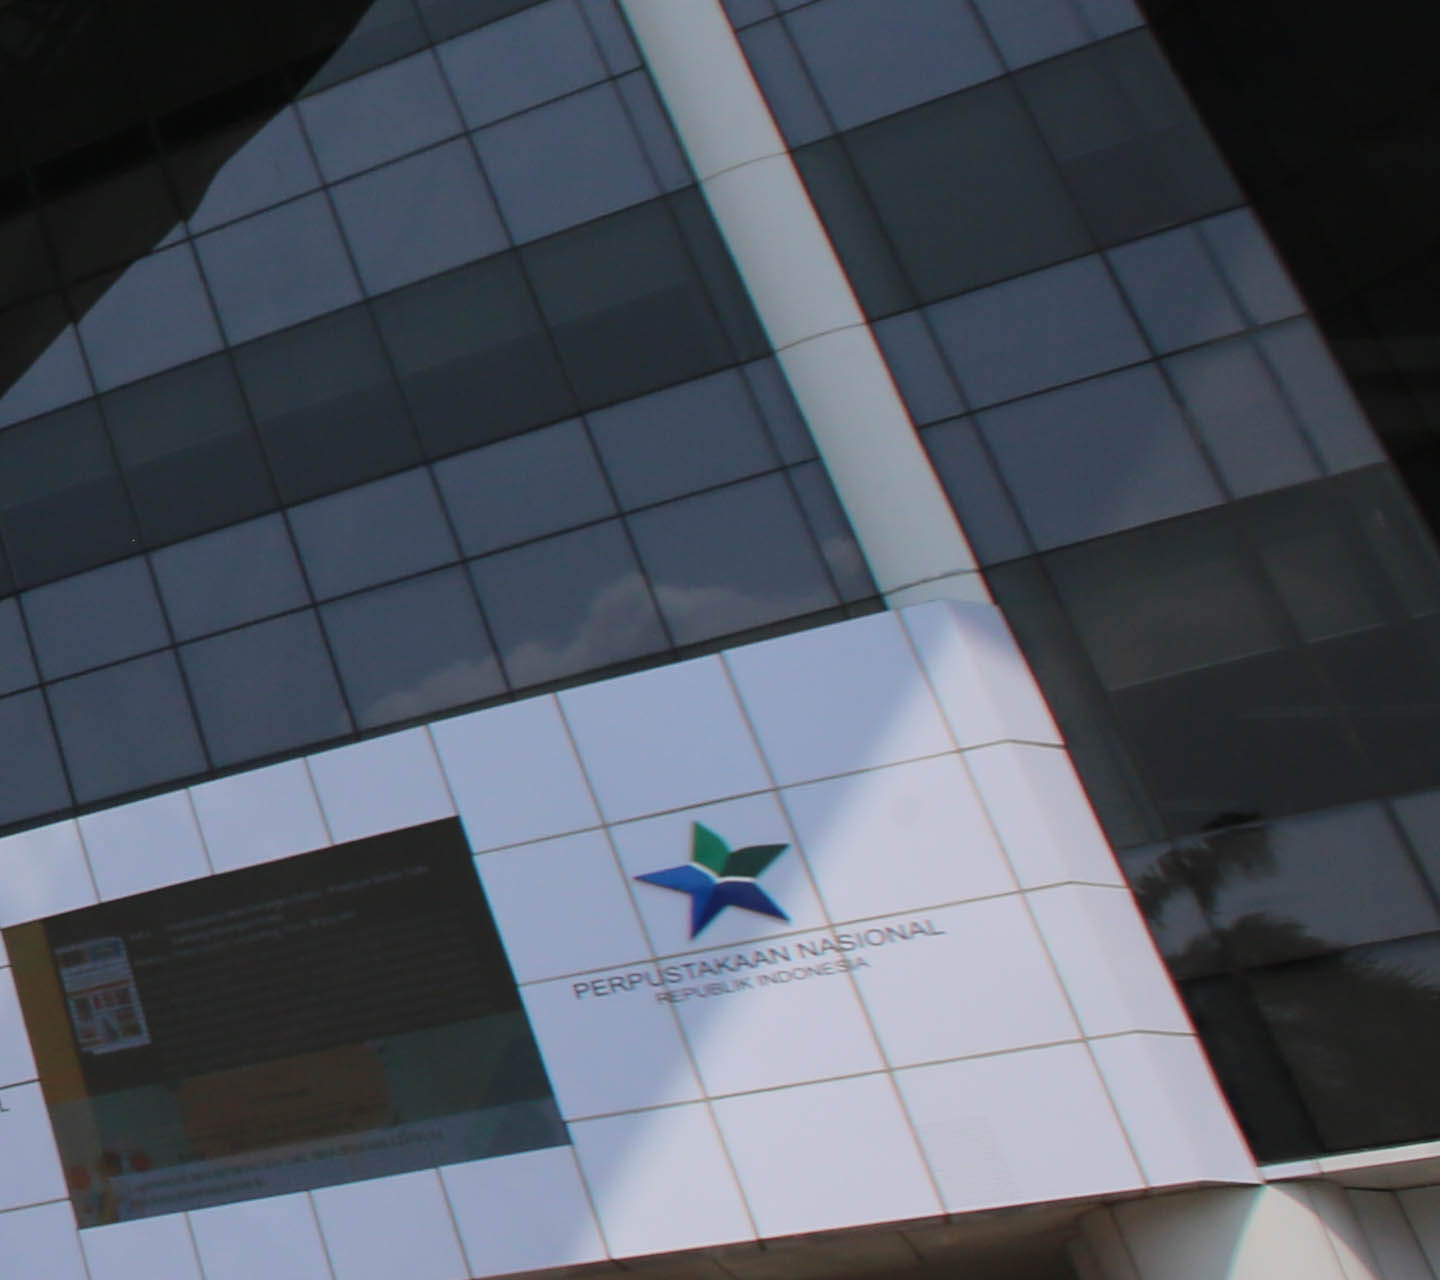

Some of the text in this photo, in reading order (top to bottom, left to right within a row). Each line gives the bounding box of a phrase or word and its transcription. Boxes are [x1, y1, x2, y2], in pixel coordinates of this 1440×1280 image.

[571, 919, 947, 1001] PERPUSTAKAAN NASIONAL
[654, 955, 871, 1005] REPUBLIK INDONESIA
